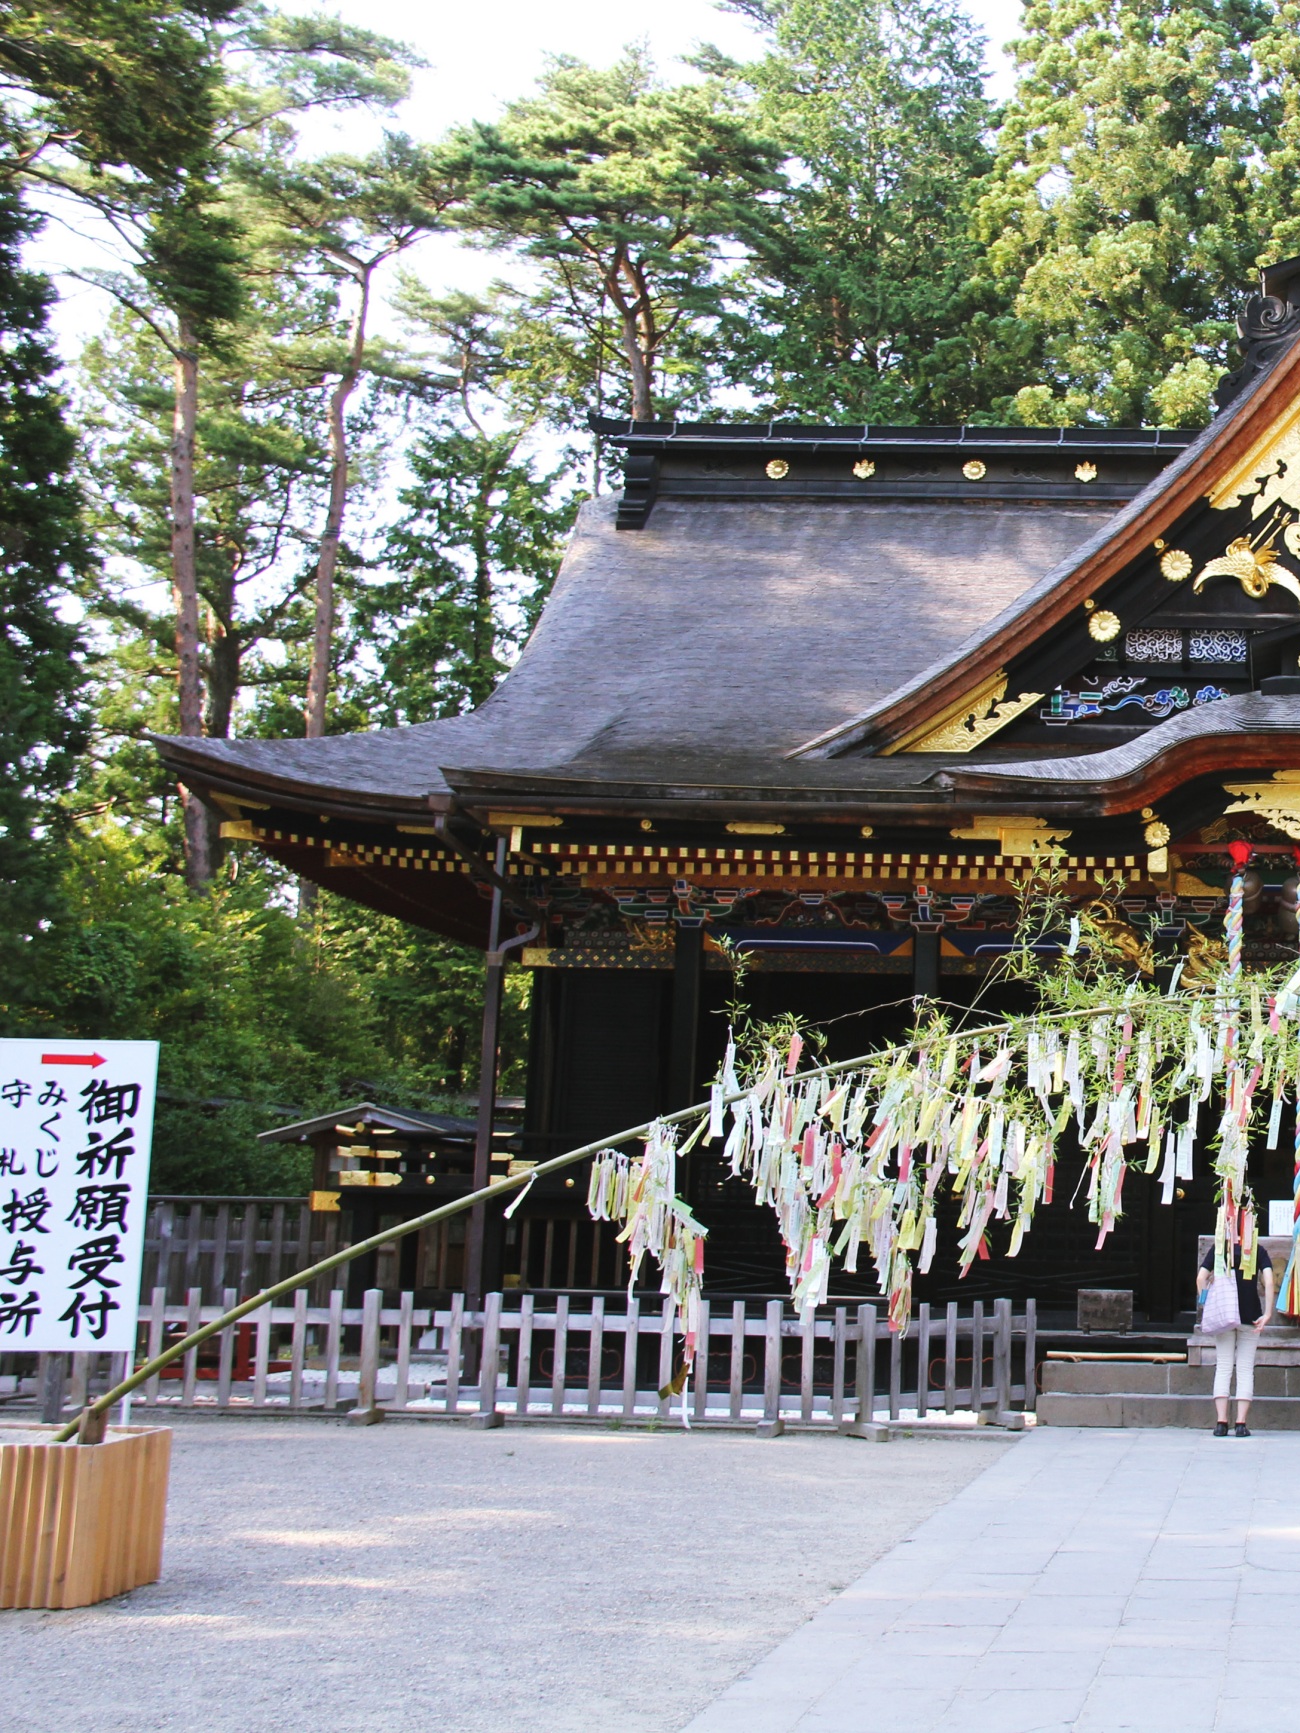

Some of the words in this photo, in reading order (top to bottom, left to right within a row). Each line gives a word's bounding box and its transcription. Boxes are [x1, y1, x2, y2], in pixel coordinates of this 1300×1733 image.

[36, 1080, 68, 1179] みくじ
[0, 1187, 52, 1338] 授与所
[58, 1079, 142, 1340] 御祈願受付
